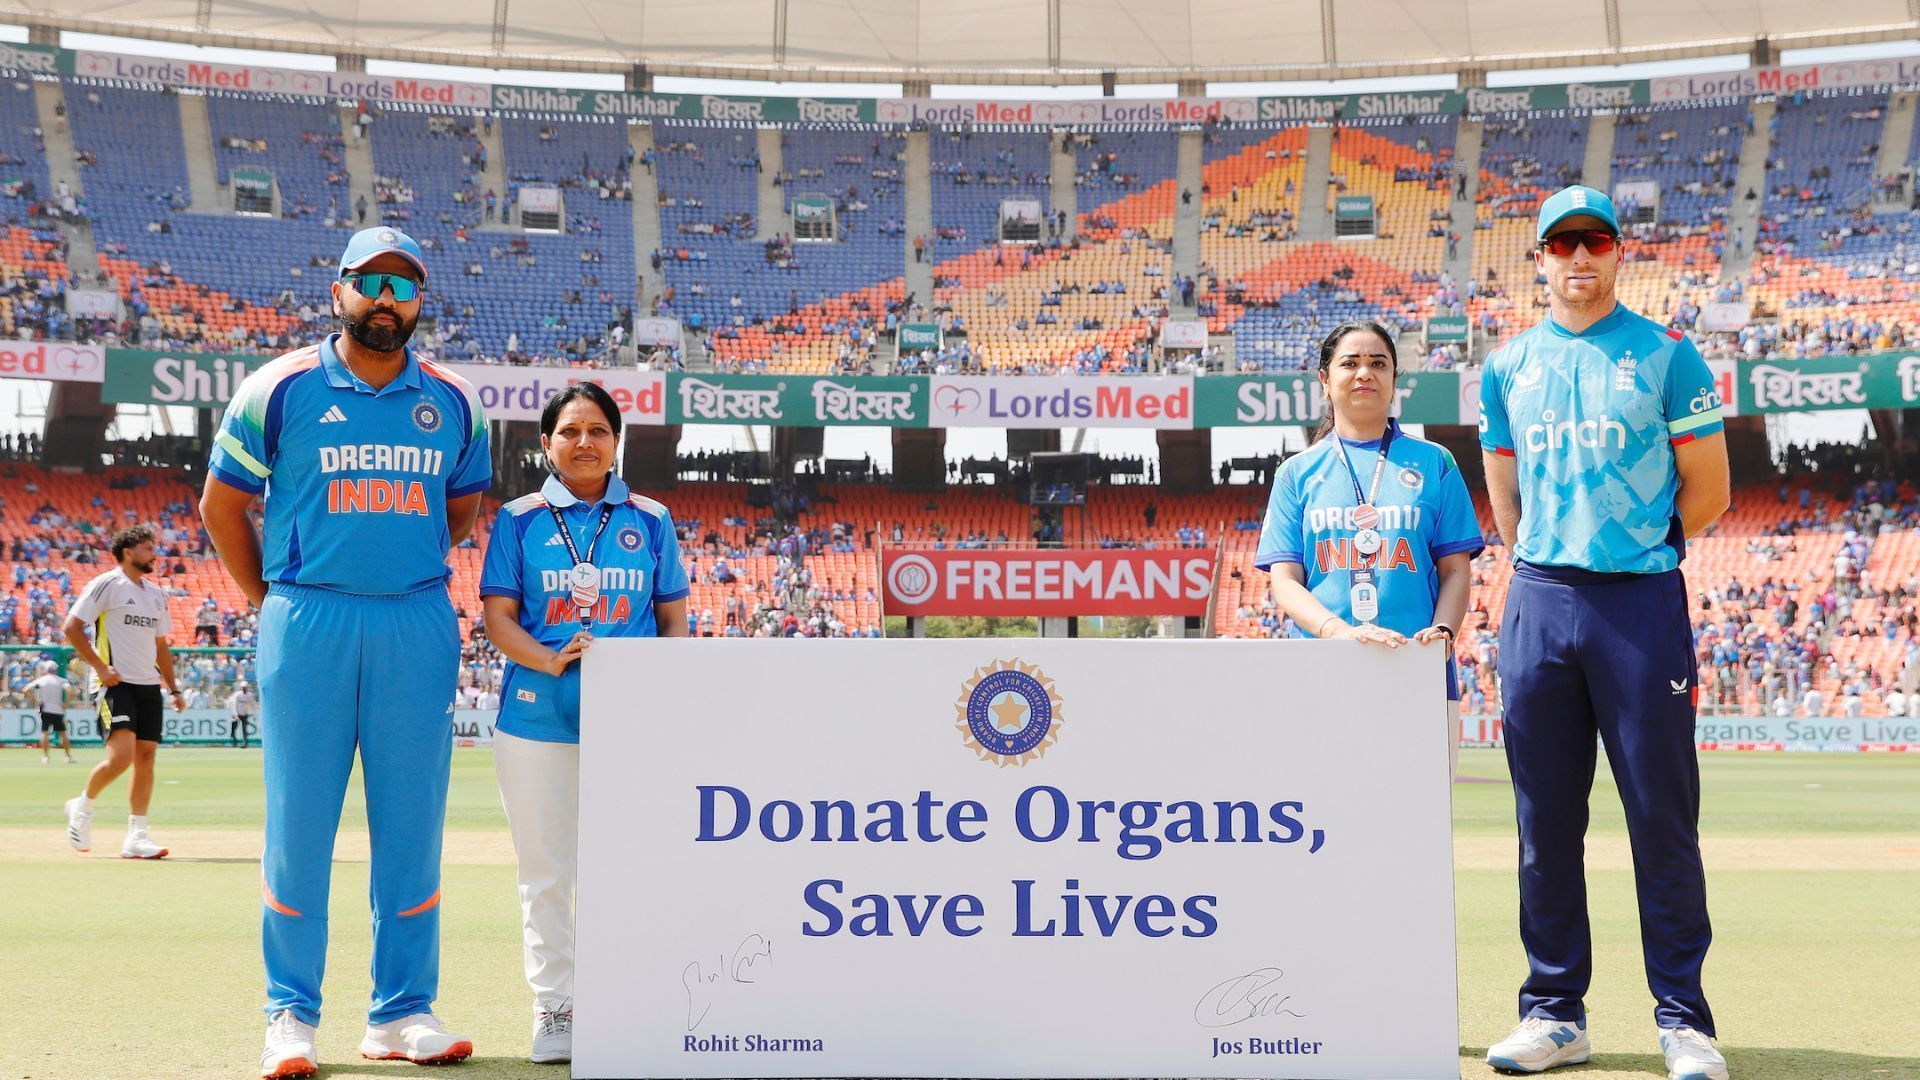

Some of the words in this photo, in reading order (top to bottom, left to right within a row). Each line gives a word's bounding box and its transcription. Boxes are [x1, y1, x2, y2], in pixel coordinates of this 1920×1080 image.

[116, 57, 250, 89] LordsMed
[1688, 67, 1818, 97] LordsMed
[327, 76, 454, 105] LordsMed
[495, 87, 581, 114] Shikhar
[594, 92, 681, 117] Shikhar
[912, 103, 1032, 123] LordsMed
[1101, 101, 1221, 122] LordsMed
[1358, 93, 1445, 118] Shikhar
[679, 377, 783, 420] शिखर
[811, 380, 916, 421] शिखर
[1750, 364, 1867, 409] शिखर
[989, 386, 1189, 419] LordsMed
[1525, 409, 1627, 453] cinch
[319, 444, 442, 476] DREAM11
[328, 478, 429, 516] INDIA
[541, 567, 644, 592] DRM11
[946, 558, 1210, 601] FREEMANS
[976, 679, 1004, 706] CONTROL
[1005, 678, 1021, 687] FOR
[1022, 682, 1044, 710] CRICKET
[1023, 725, 1041, 743] INDIA
[1786, 721, 1851, 741] Save
[695, 785, 988, 843] Donate
[1015, 785, 1325, 861] Organs,
[802, 878, 985, 937] Save
[1011, 879, 1218, 938] Lives
[684, 1034, 740, 1052] Rohit
[744, 1034, 824, 1052] Sharma
[1212, 1037, 1243, 1058] Jos
[1249, 1037, 1323, 1055] Buttler
